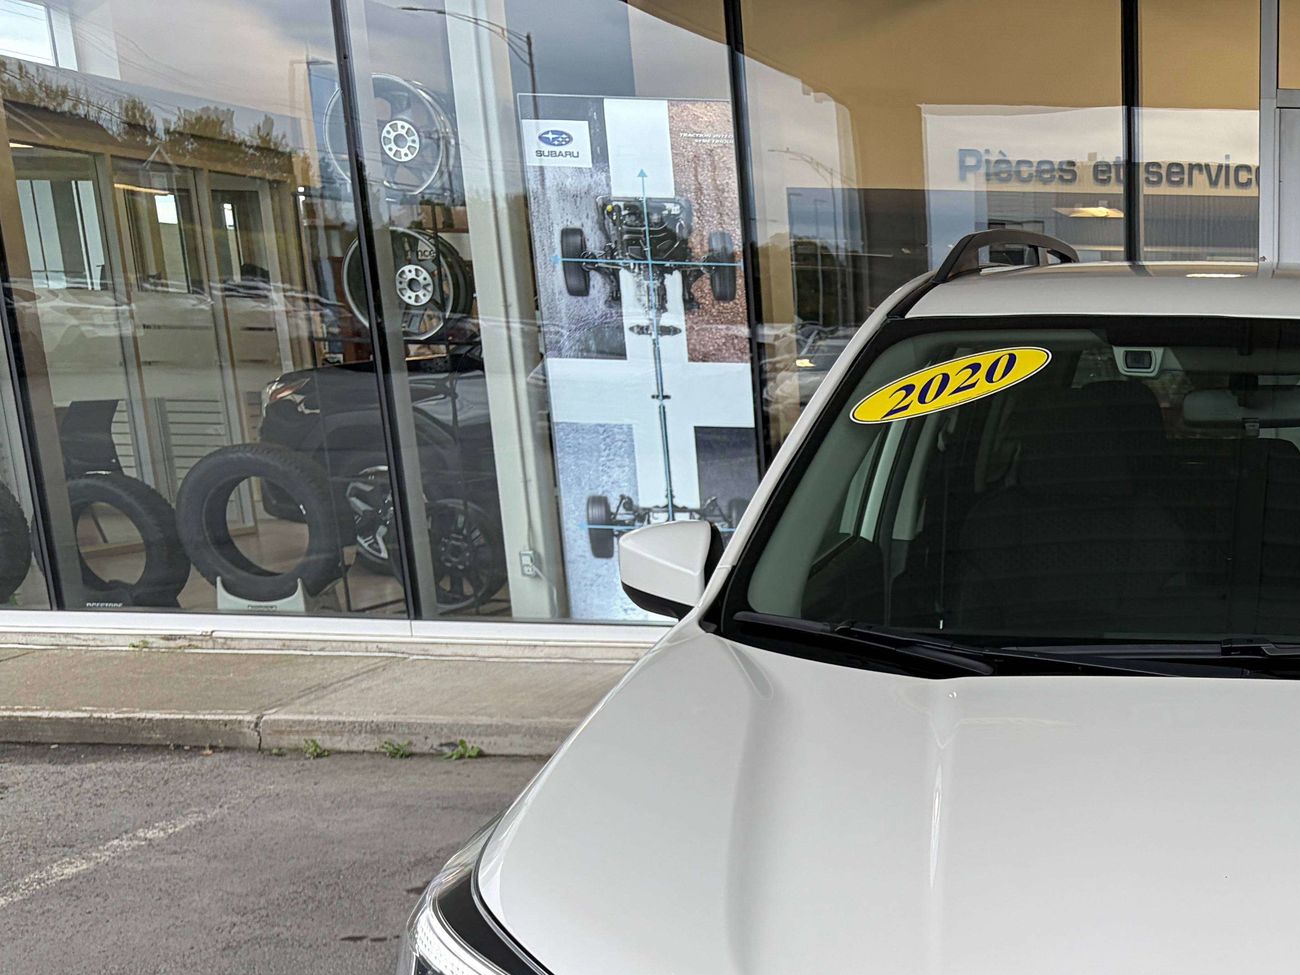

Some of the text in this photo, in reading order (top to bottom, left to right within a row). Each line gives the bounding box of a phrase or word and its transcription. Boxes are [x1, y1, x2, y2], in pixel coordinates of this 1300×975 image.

[535, 149, 580, 158] SUBARU
[957, 148, 1260, 189] Pièces et servic
[880, 352, 1017, 419] 2020
